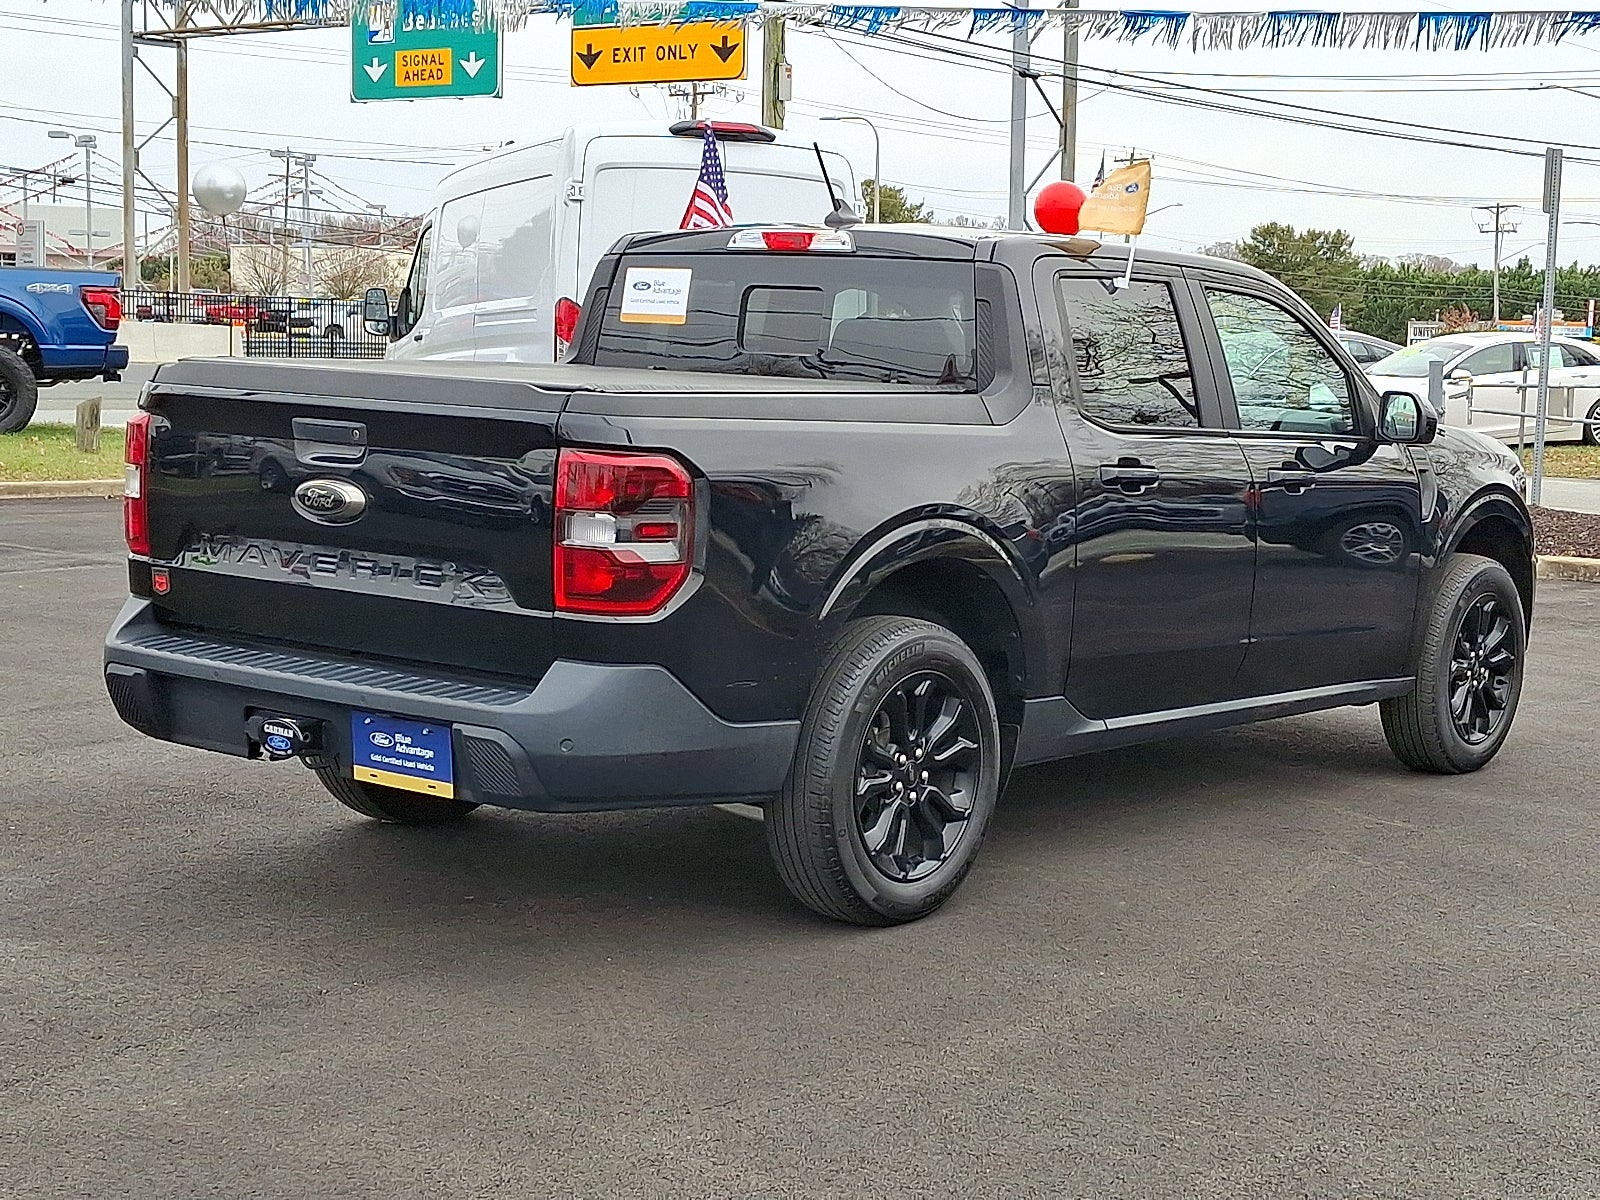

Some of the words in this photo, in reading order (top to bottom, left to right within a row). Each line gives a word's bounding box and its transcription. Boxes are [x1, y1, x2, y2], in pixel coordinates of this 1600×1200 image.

[401, 54, 445, 67] SIGNAL
[612, 46, 646, 64] EXIT
[655, 43, 698, 61] ONLY
[403, 68, 443, 82] AHEAD
[26, 282, 73, 294] 4x4
[303, 487, 338, 509] Ford
[198, 534, 498, 602] MAVERICK
[371, 733, 391, 746] Ford
[395, 733, 412, 744] Blue
[395, 743, 434, 759] Advantage
